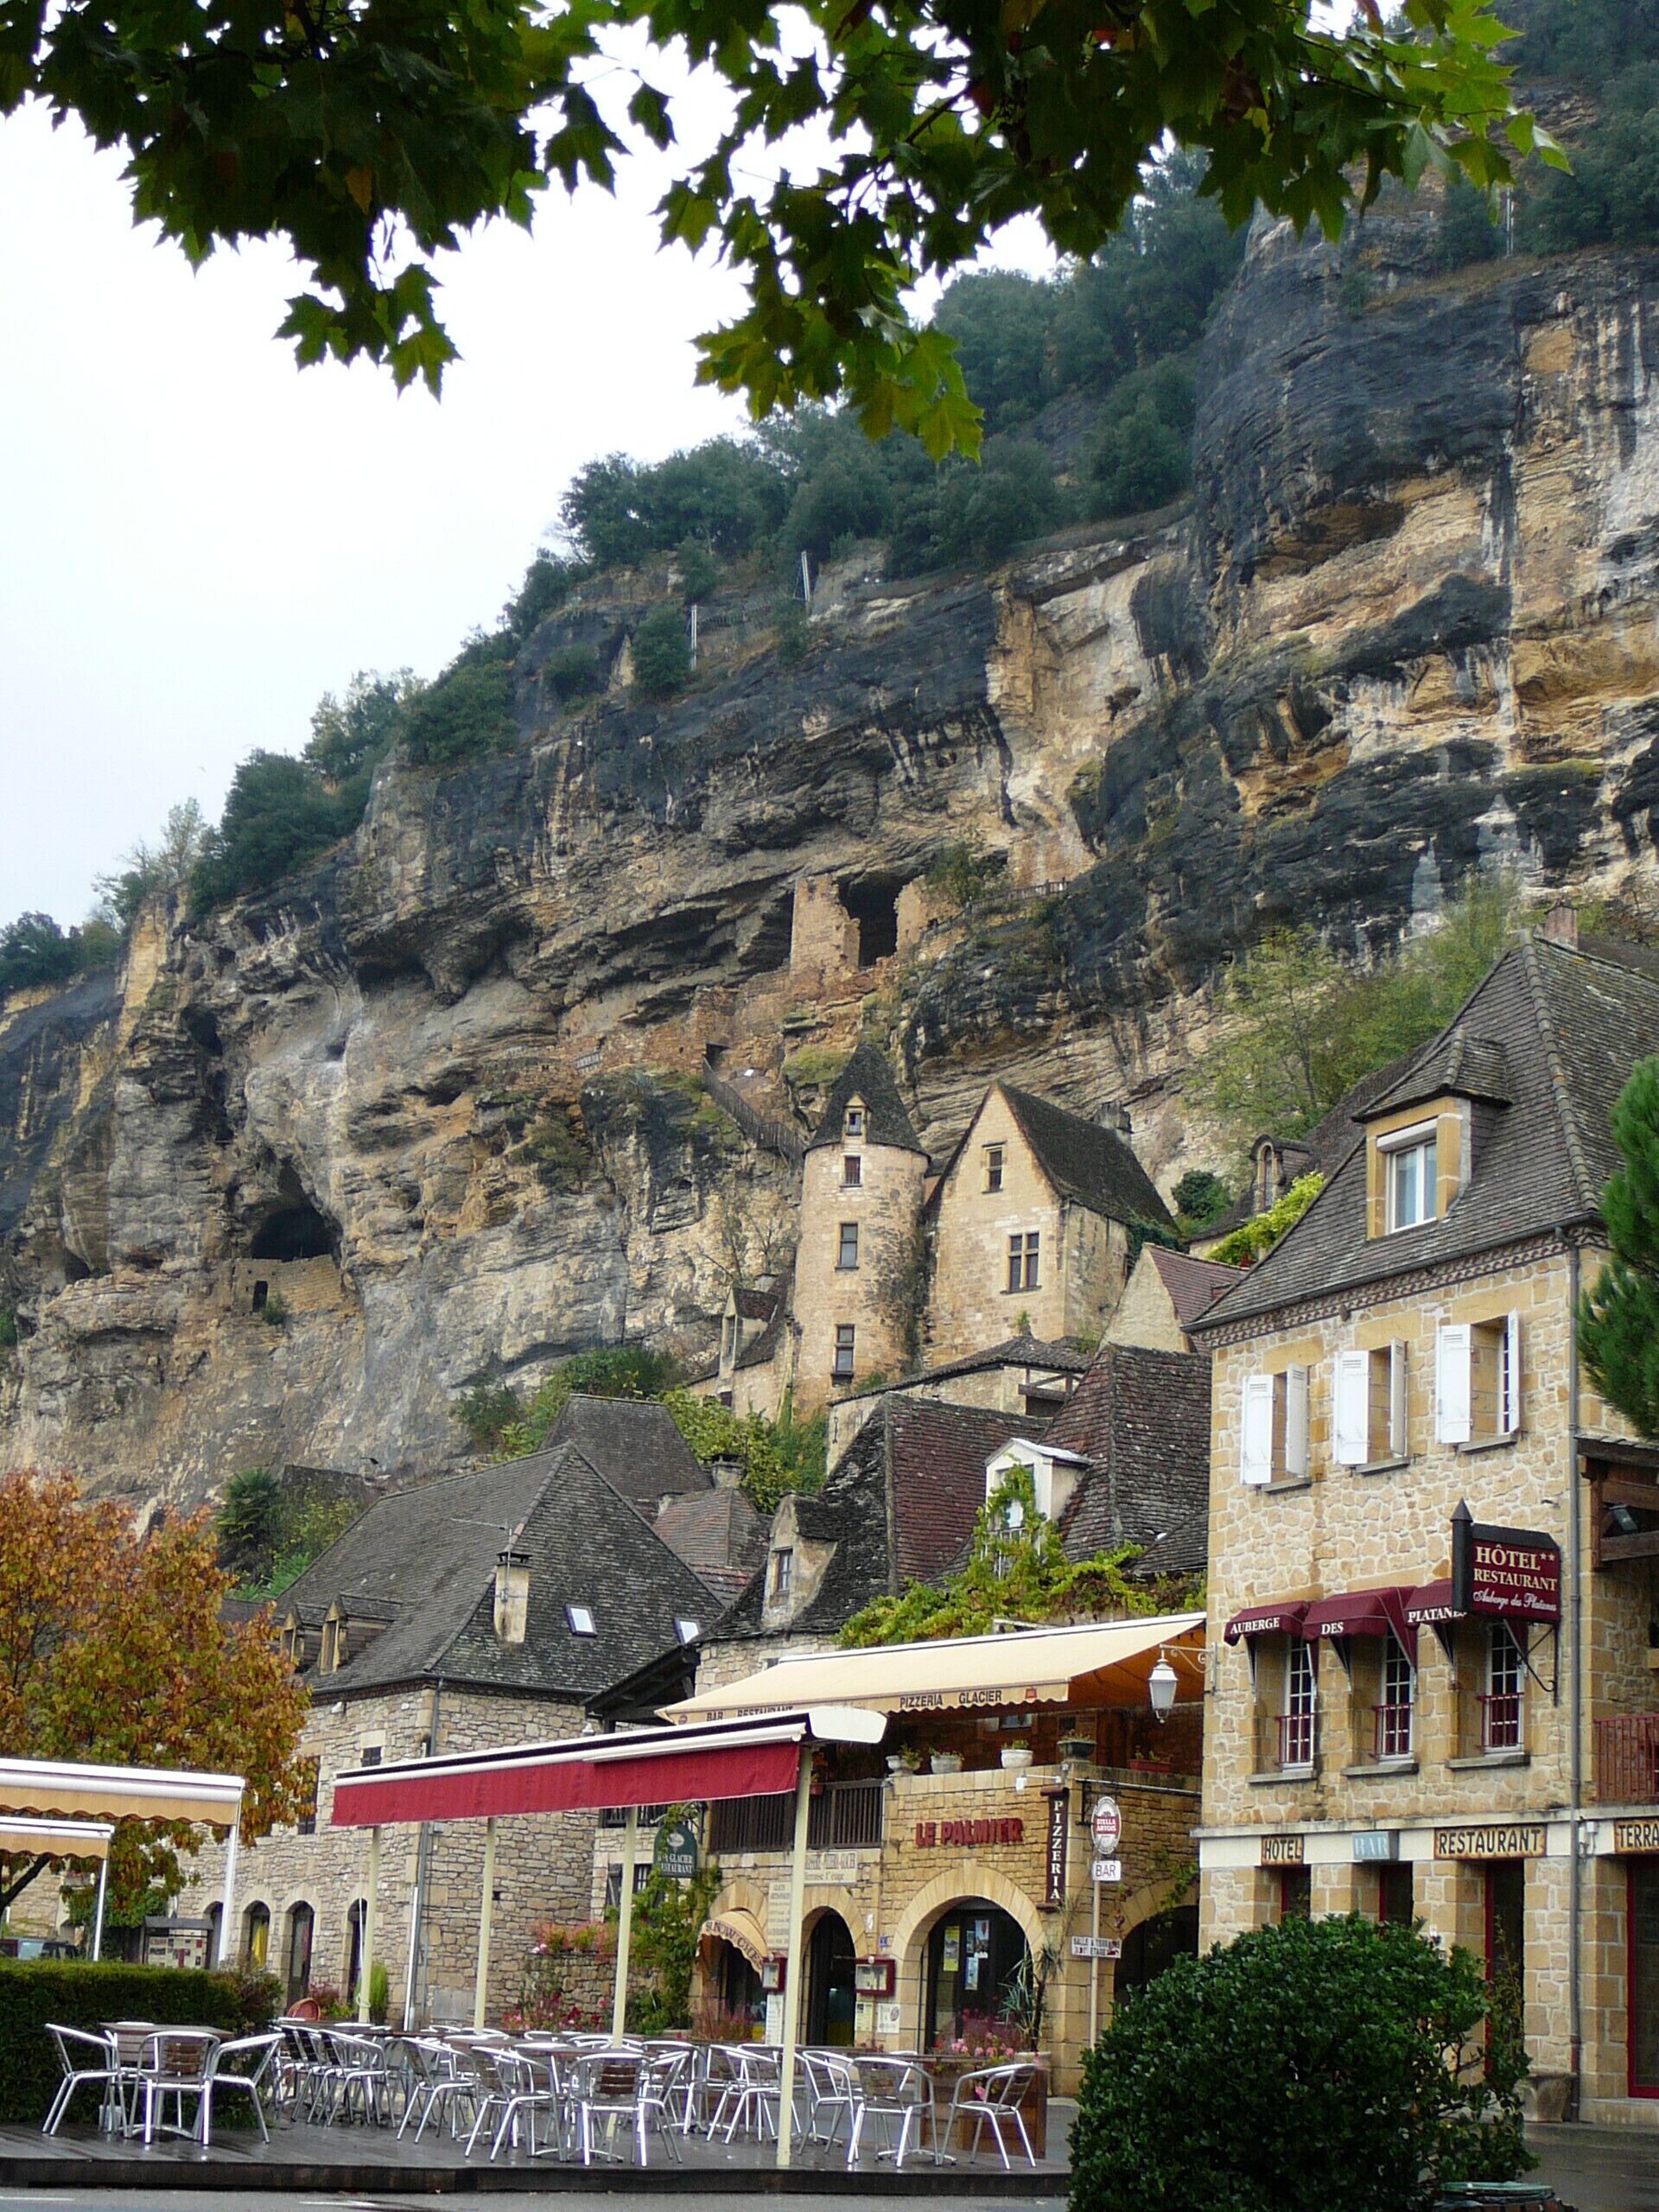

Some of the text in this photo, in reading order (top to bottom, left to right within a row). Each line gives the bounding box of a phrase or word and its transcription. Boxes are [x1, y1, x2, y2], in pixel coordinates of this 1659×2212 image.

[1476, 1544, 1541, 1571] HÔTEL
[1474, 1568, 1557, 1591] RESTAURANT
[1473, 1588, 1509, 1610] Auberge
[1230, 1618, 1280, 1634] AUBERGE
[1321, 1622, 1344, 1635] DES
[707, 1712, 723, 1721] BAR
[899, 1694, 943, 1707] PIZZERIA
[959, 1690, 1002, 1704] GLACIER
[916, 1817, 1024, 1847] LE PALMIER
[1439, 1829, 1541, 1854] RESTAURANT
[1049, 1800, 1064, 1899] PIZZERIA
[1264, 1839, 1300, 1860] HOTEL
[1354, 1835, 1389, 1857] BAR
[1096, 1864, 1116, 1877] BAR
